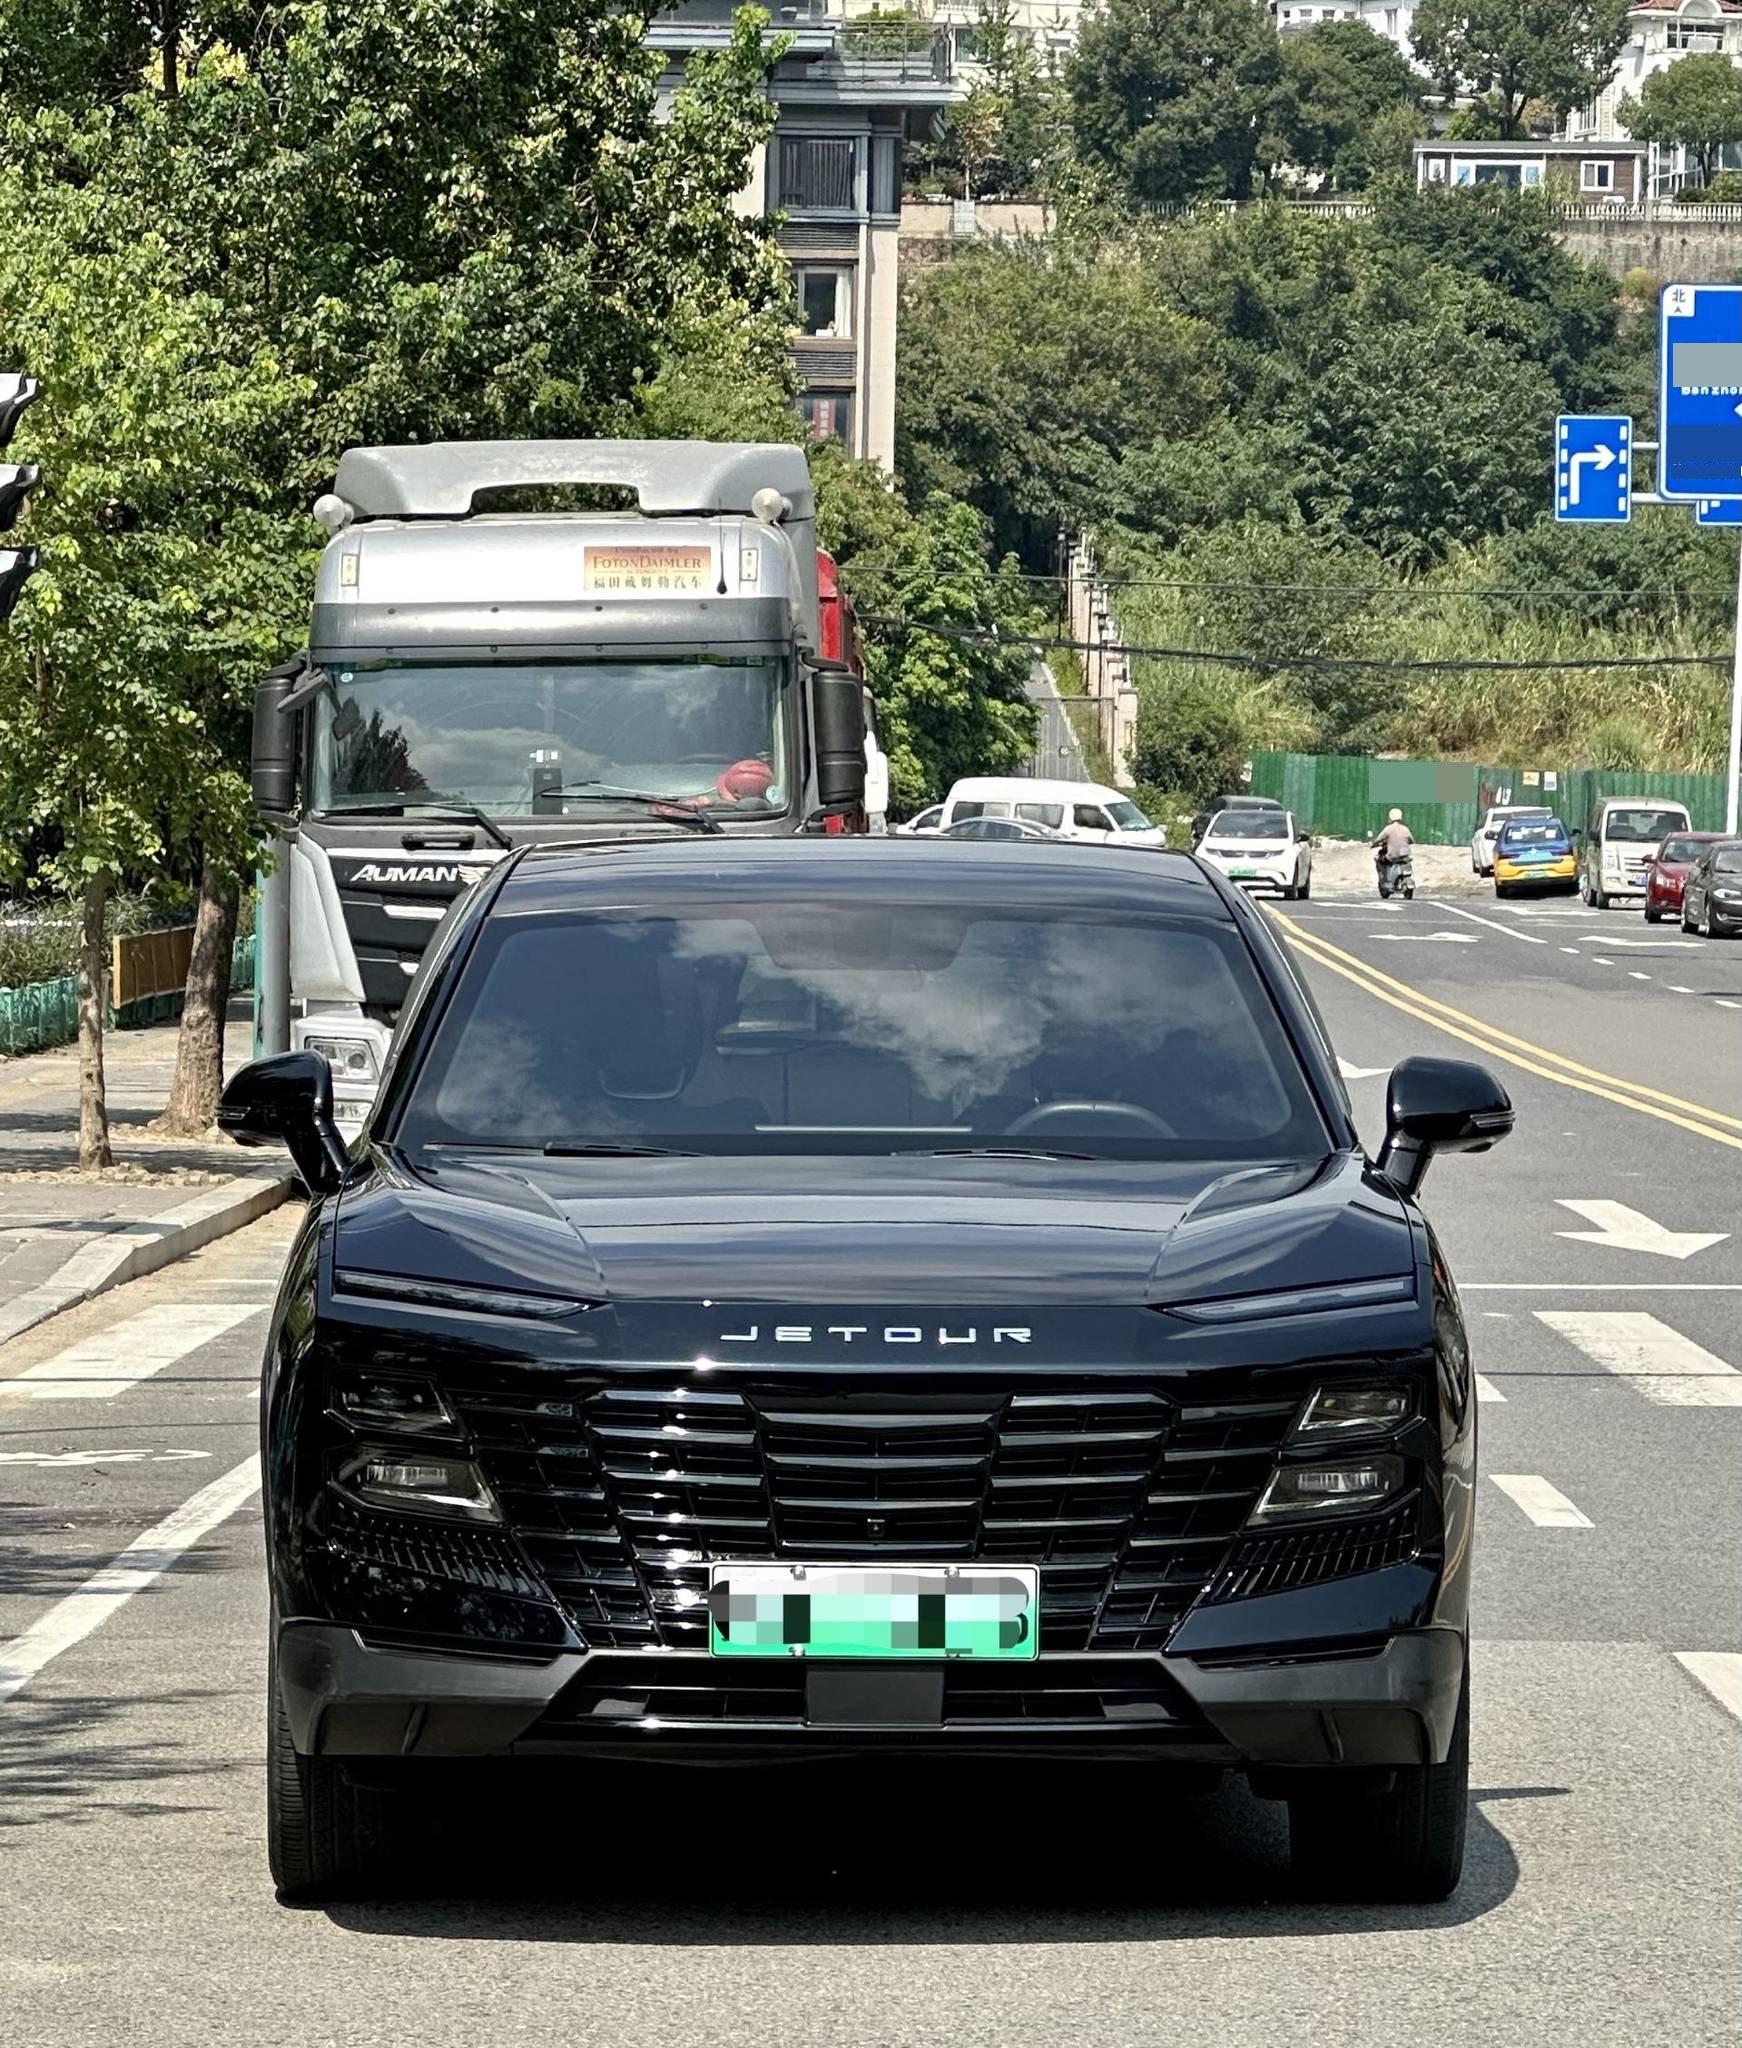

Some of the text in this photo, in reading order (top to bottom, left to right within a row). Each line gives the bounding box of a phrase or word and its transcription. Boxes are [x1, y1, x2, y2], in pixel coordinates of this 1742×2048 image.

[1672, 288, 1686, 302] 北
[350, 864, 459, 882] AUMAN
[720, 1326, 1032, 1344] JETOUR
